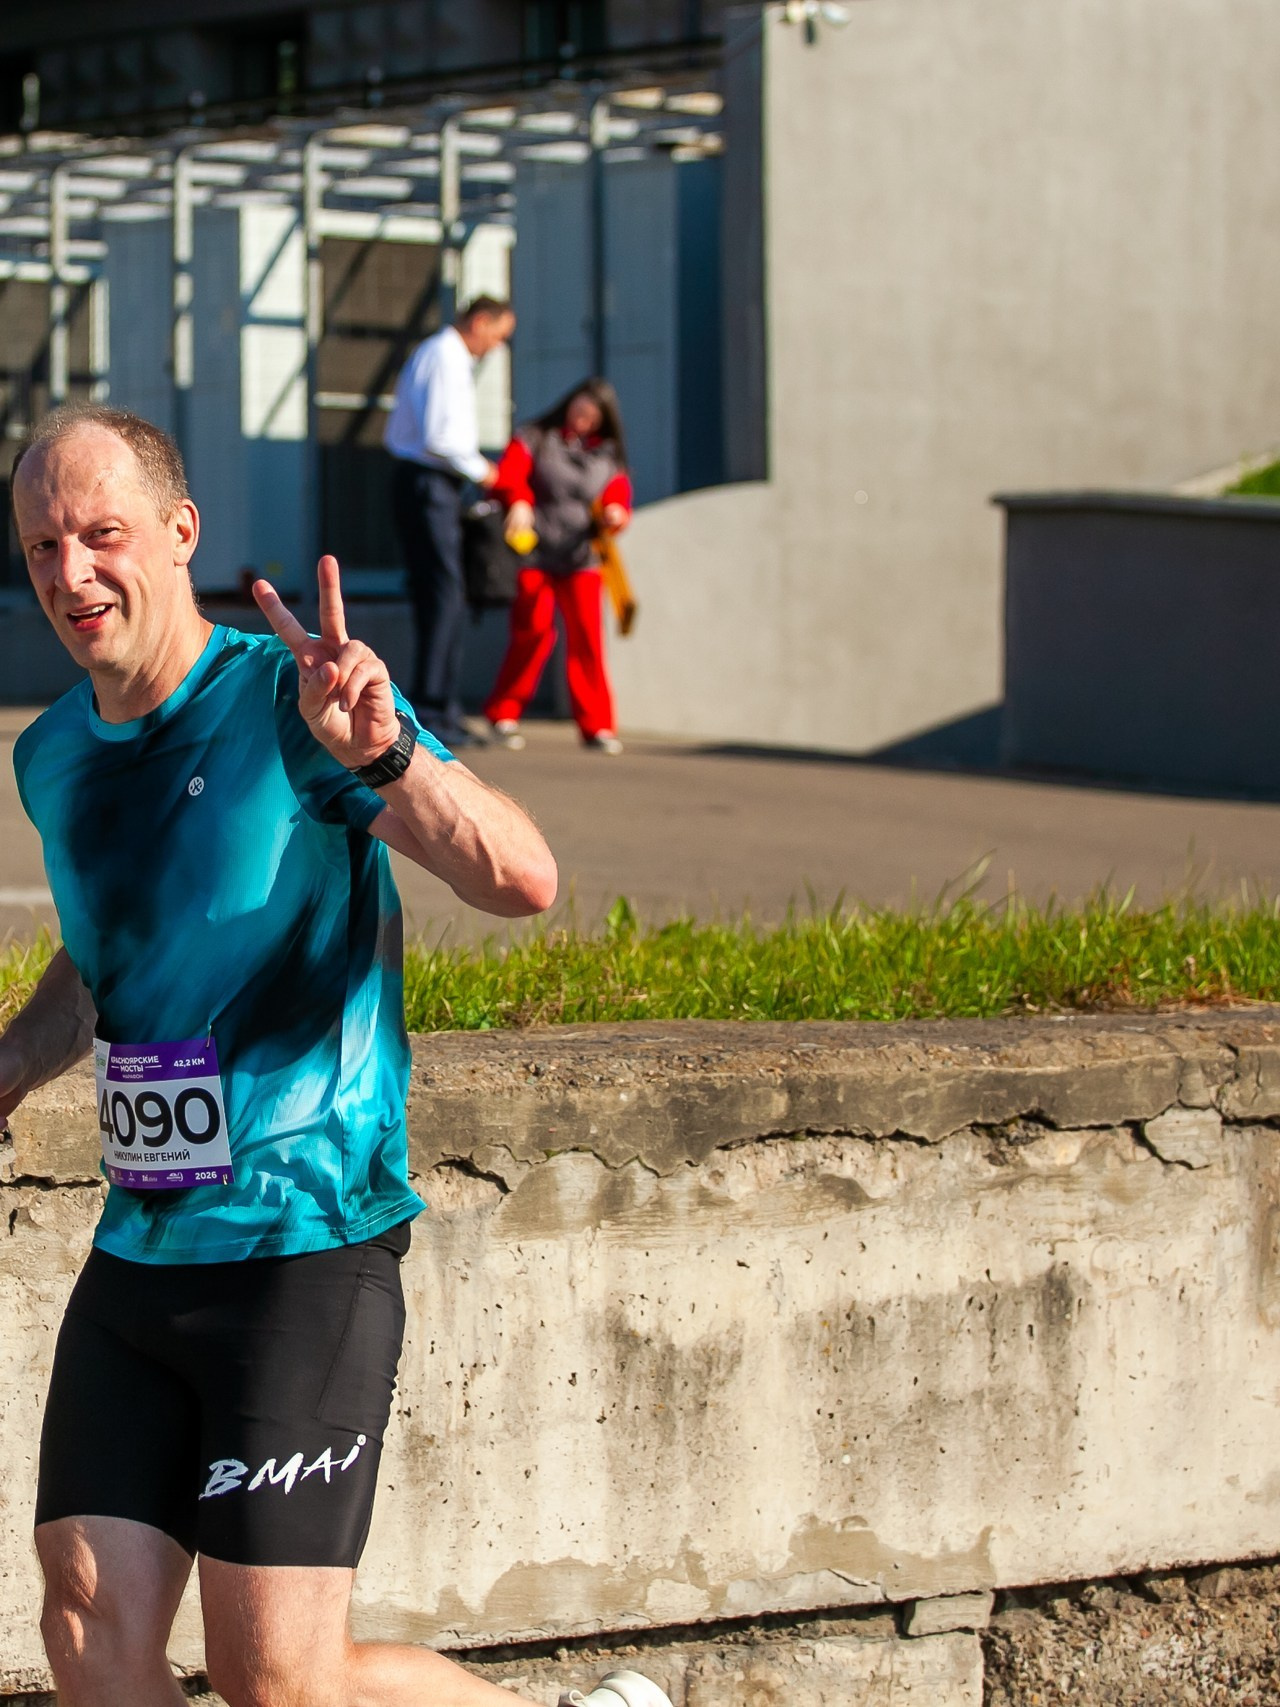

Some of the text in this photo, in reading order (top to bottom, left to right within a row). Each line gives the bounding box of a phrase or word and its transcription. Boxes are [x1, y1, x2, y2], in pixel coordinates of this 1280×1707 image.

[173, 1057, 206, 1068] 42,2 КМ
[99, 1087, 221, 1148] 4090
[143, 1148, 191, 1163] ЕВГЕНИЙ
[194, 1171, 218, 1180] 2026
